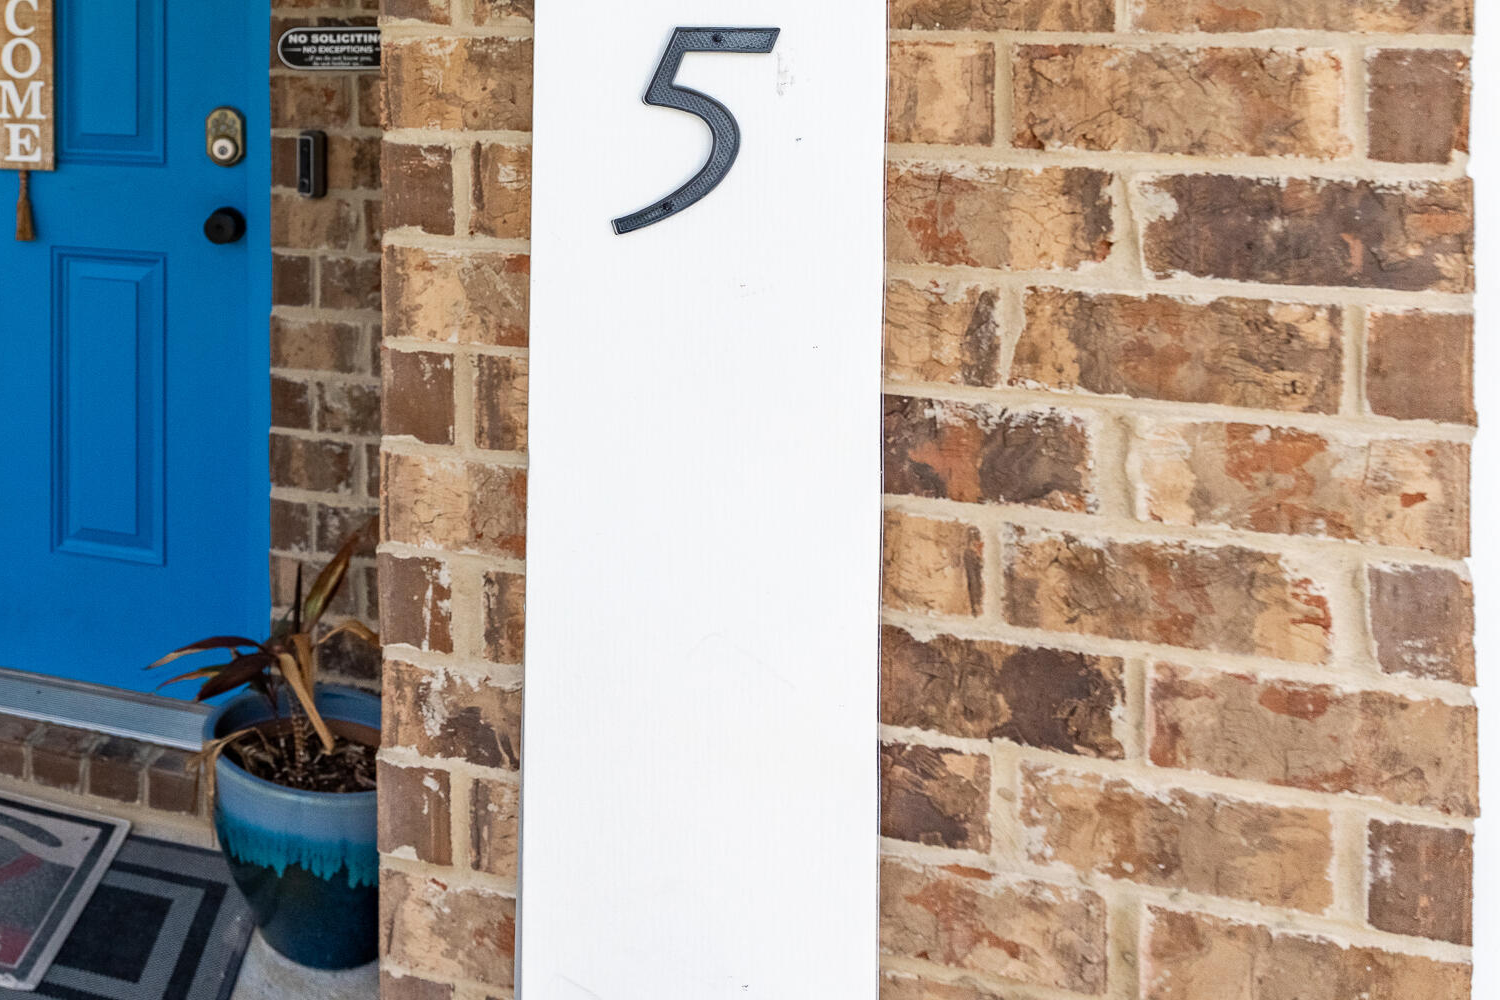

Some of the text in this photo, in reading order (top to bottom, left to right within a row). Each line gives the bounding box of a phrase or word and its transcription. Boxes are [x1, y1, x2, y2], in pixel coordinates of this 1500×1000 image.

[288, 33, 380, 44] NO SOLICITIN
[302, 45, 373, 54] NO EXCEPTIONS
